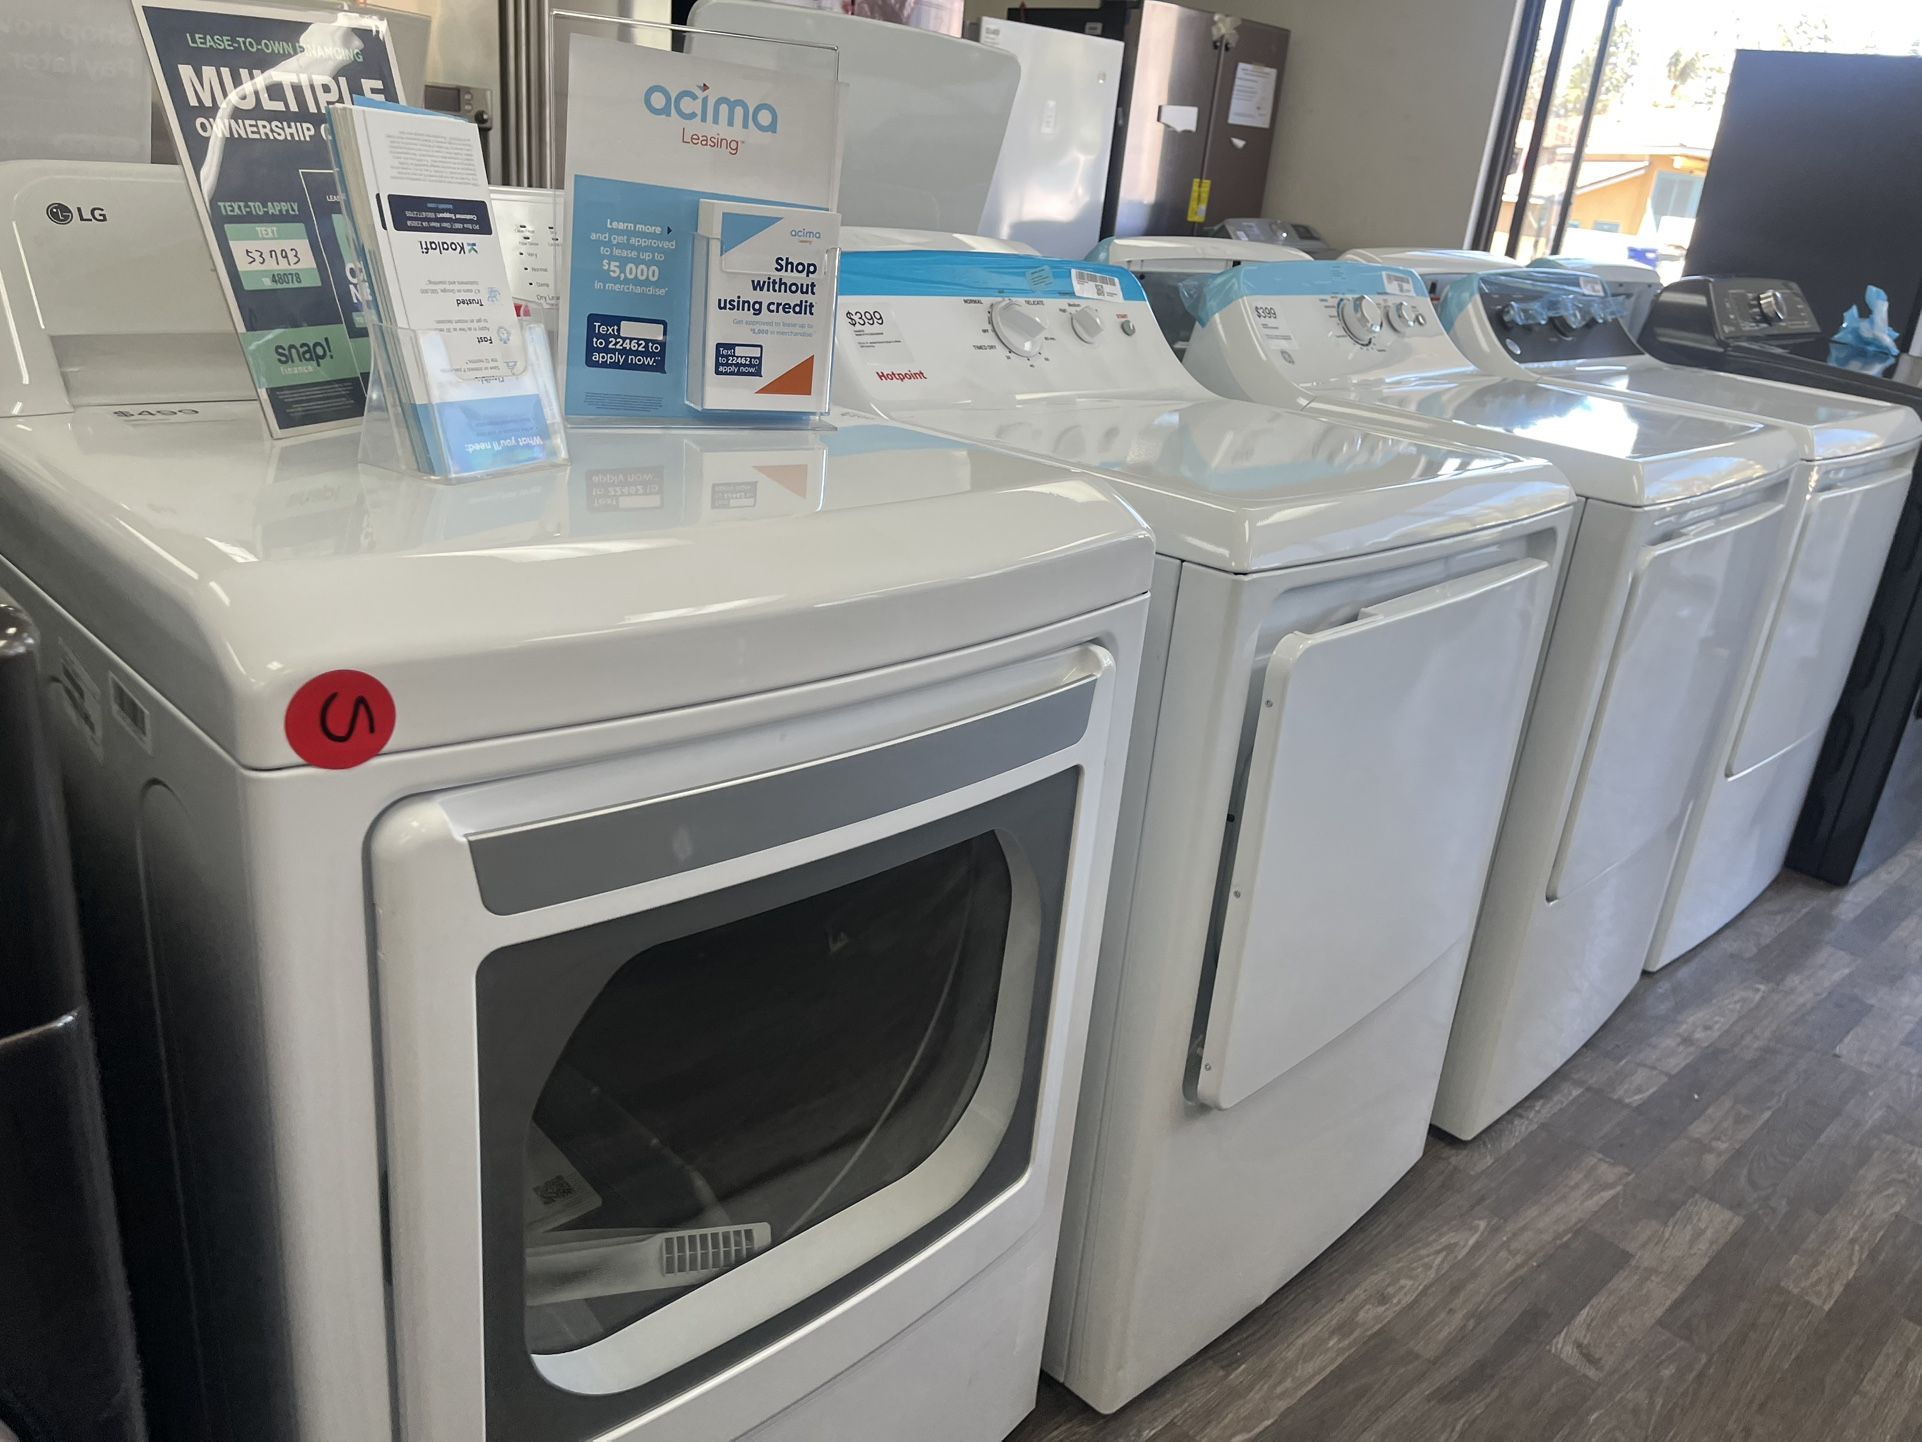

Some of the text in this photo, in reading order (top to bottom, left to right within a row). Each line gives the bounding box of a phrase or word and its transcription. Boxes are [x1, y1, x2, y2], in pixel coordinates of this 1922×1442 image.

[186, 33, 364, 62] LEASE-TO-OWN FINANCING
[643, 82, 778, 134] acima
[195, 116, 316, 142] OWNERSHIP
[76, 206, 108, 222] LG
[218, 201, 300, 216] TEXT-TO-APPLY
[256, 226, 278, 238] TEXT
[607, 218, 662, 234] Learn more
[790, 228, 822, 239] acima
[418, 240, 466, 255] Koalafi
[590, 232, 676, 249] and get approved
[600, 246, 665, 261] to lease up to
[602, 258, 660, 282] $5,000
[774, 256, 818, 278] Shop
[271, 272, 302, 285] 48078
[751, 276, 817, 296] without
[455, 298, 484, 307] Trusted
[717, 295, 815, 316] using credit
[845, 310, 884, 328] $399
[1254, 305, 1278, 319] $399
[594, 322, 619, 335] Text
[476, 336, 493, 344] Fast
[592, 337, 661, 353] to 22462 to
[274, 336, 334, 368] snap!
[592, 351, 626, 366] apply
[719, 347, 734, 356] Text
[718, 356, 727, 364] to
[727, 356, 751, 365] 22462
[718, 364, 739, 374] apply
[876, 369, 928, 382] Hotpoint
[518, 435, 543, 447] What
